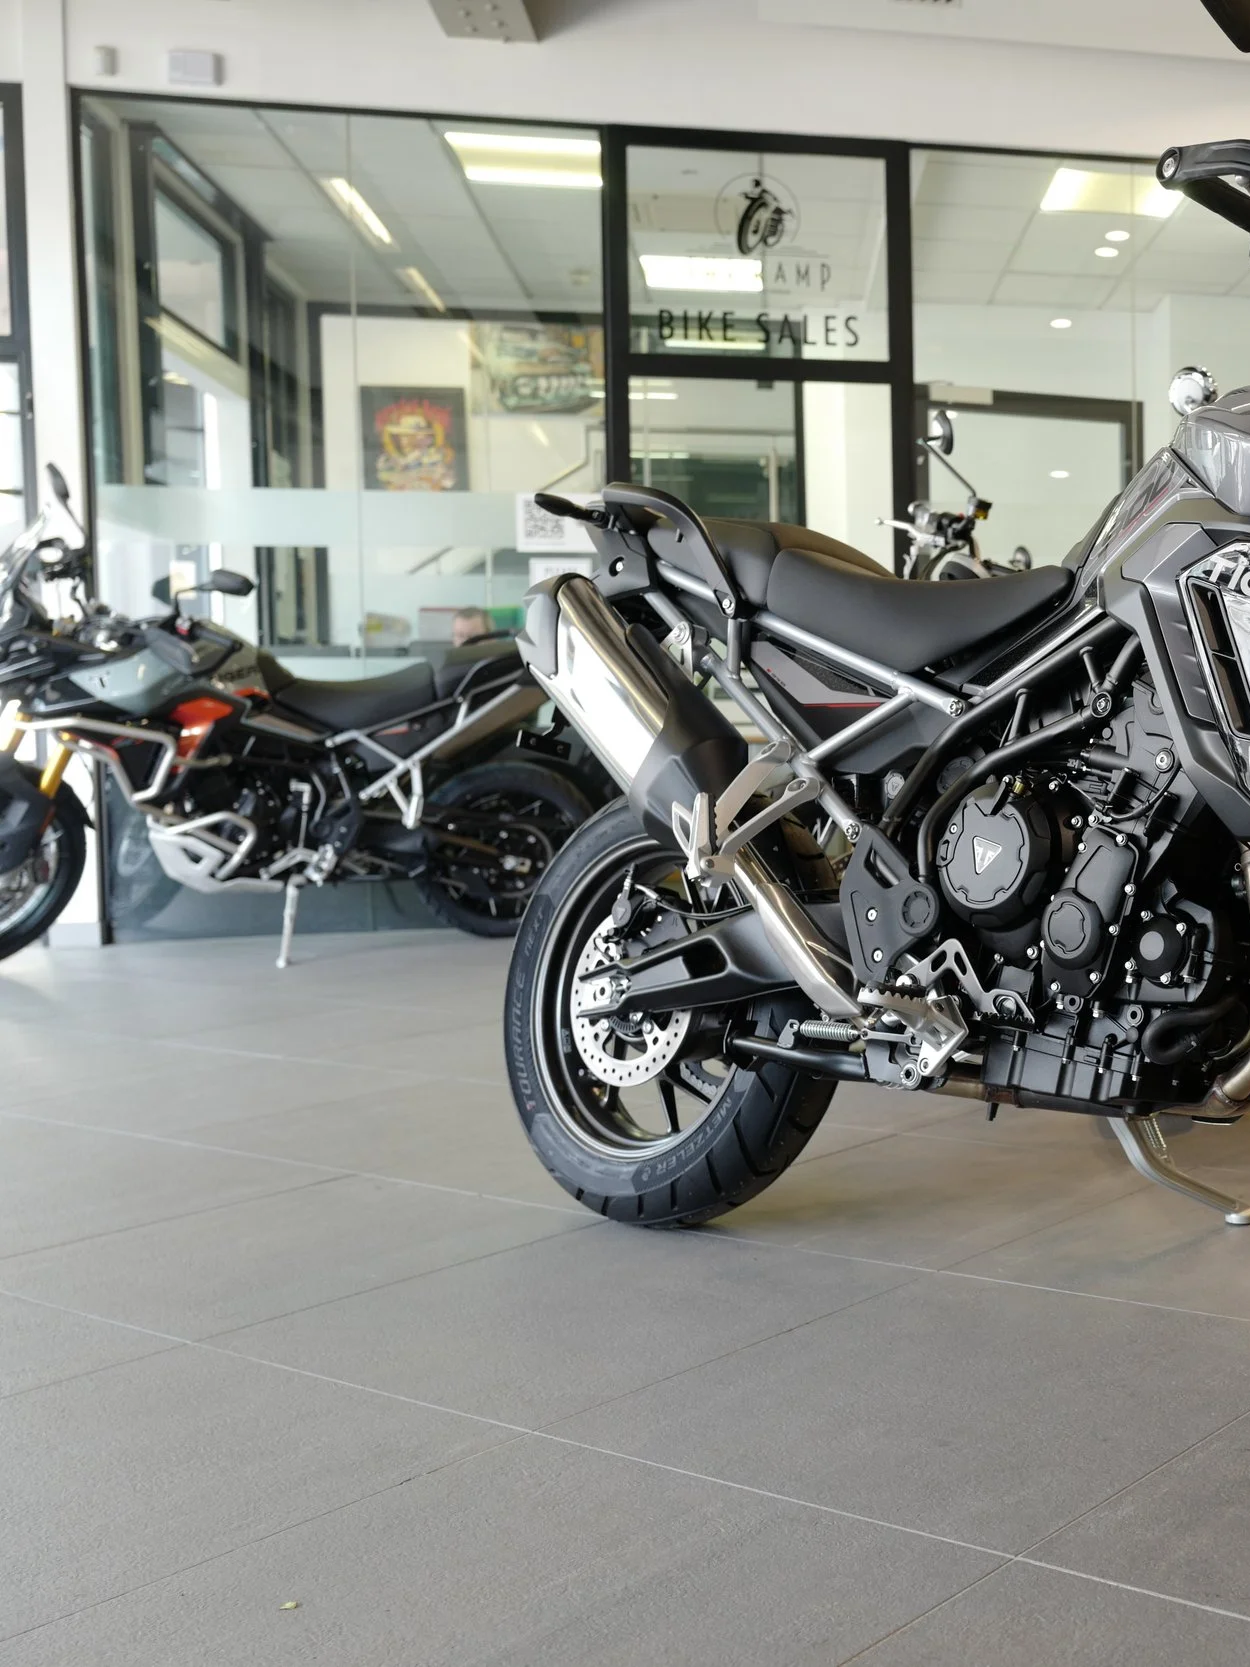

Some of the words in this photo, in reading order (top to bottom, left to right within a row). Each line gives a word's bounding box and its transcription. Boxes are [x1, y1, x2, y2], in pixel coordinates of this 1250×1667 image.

[658, 309, 735, 342] BIKE
[756, 312, 860, 347] SALES
[511, 967, 537, 1111] TOURANCE
[656, 1096, 732, 1176] METZELER
